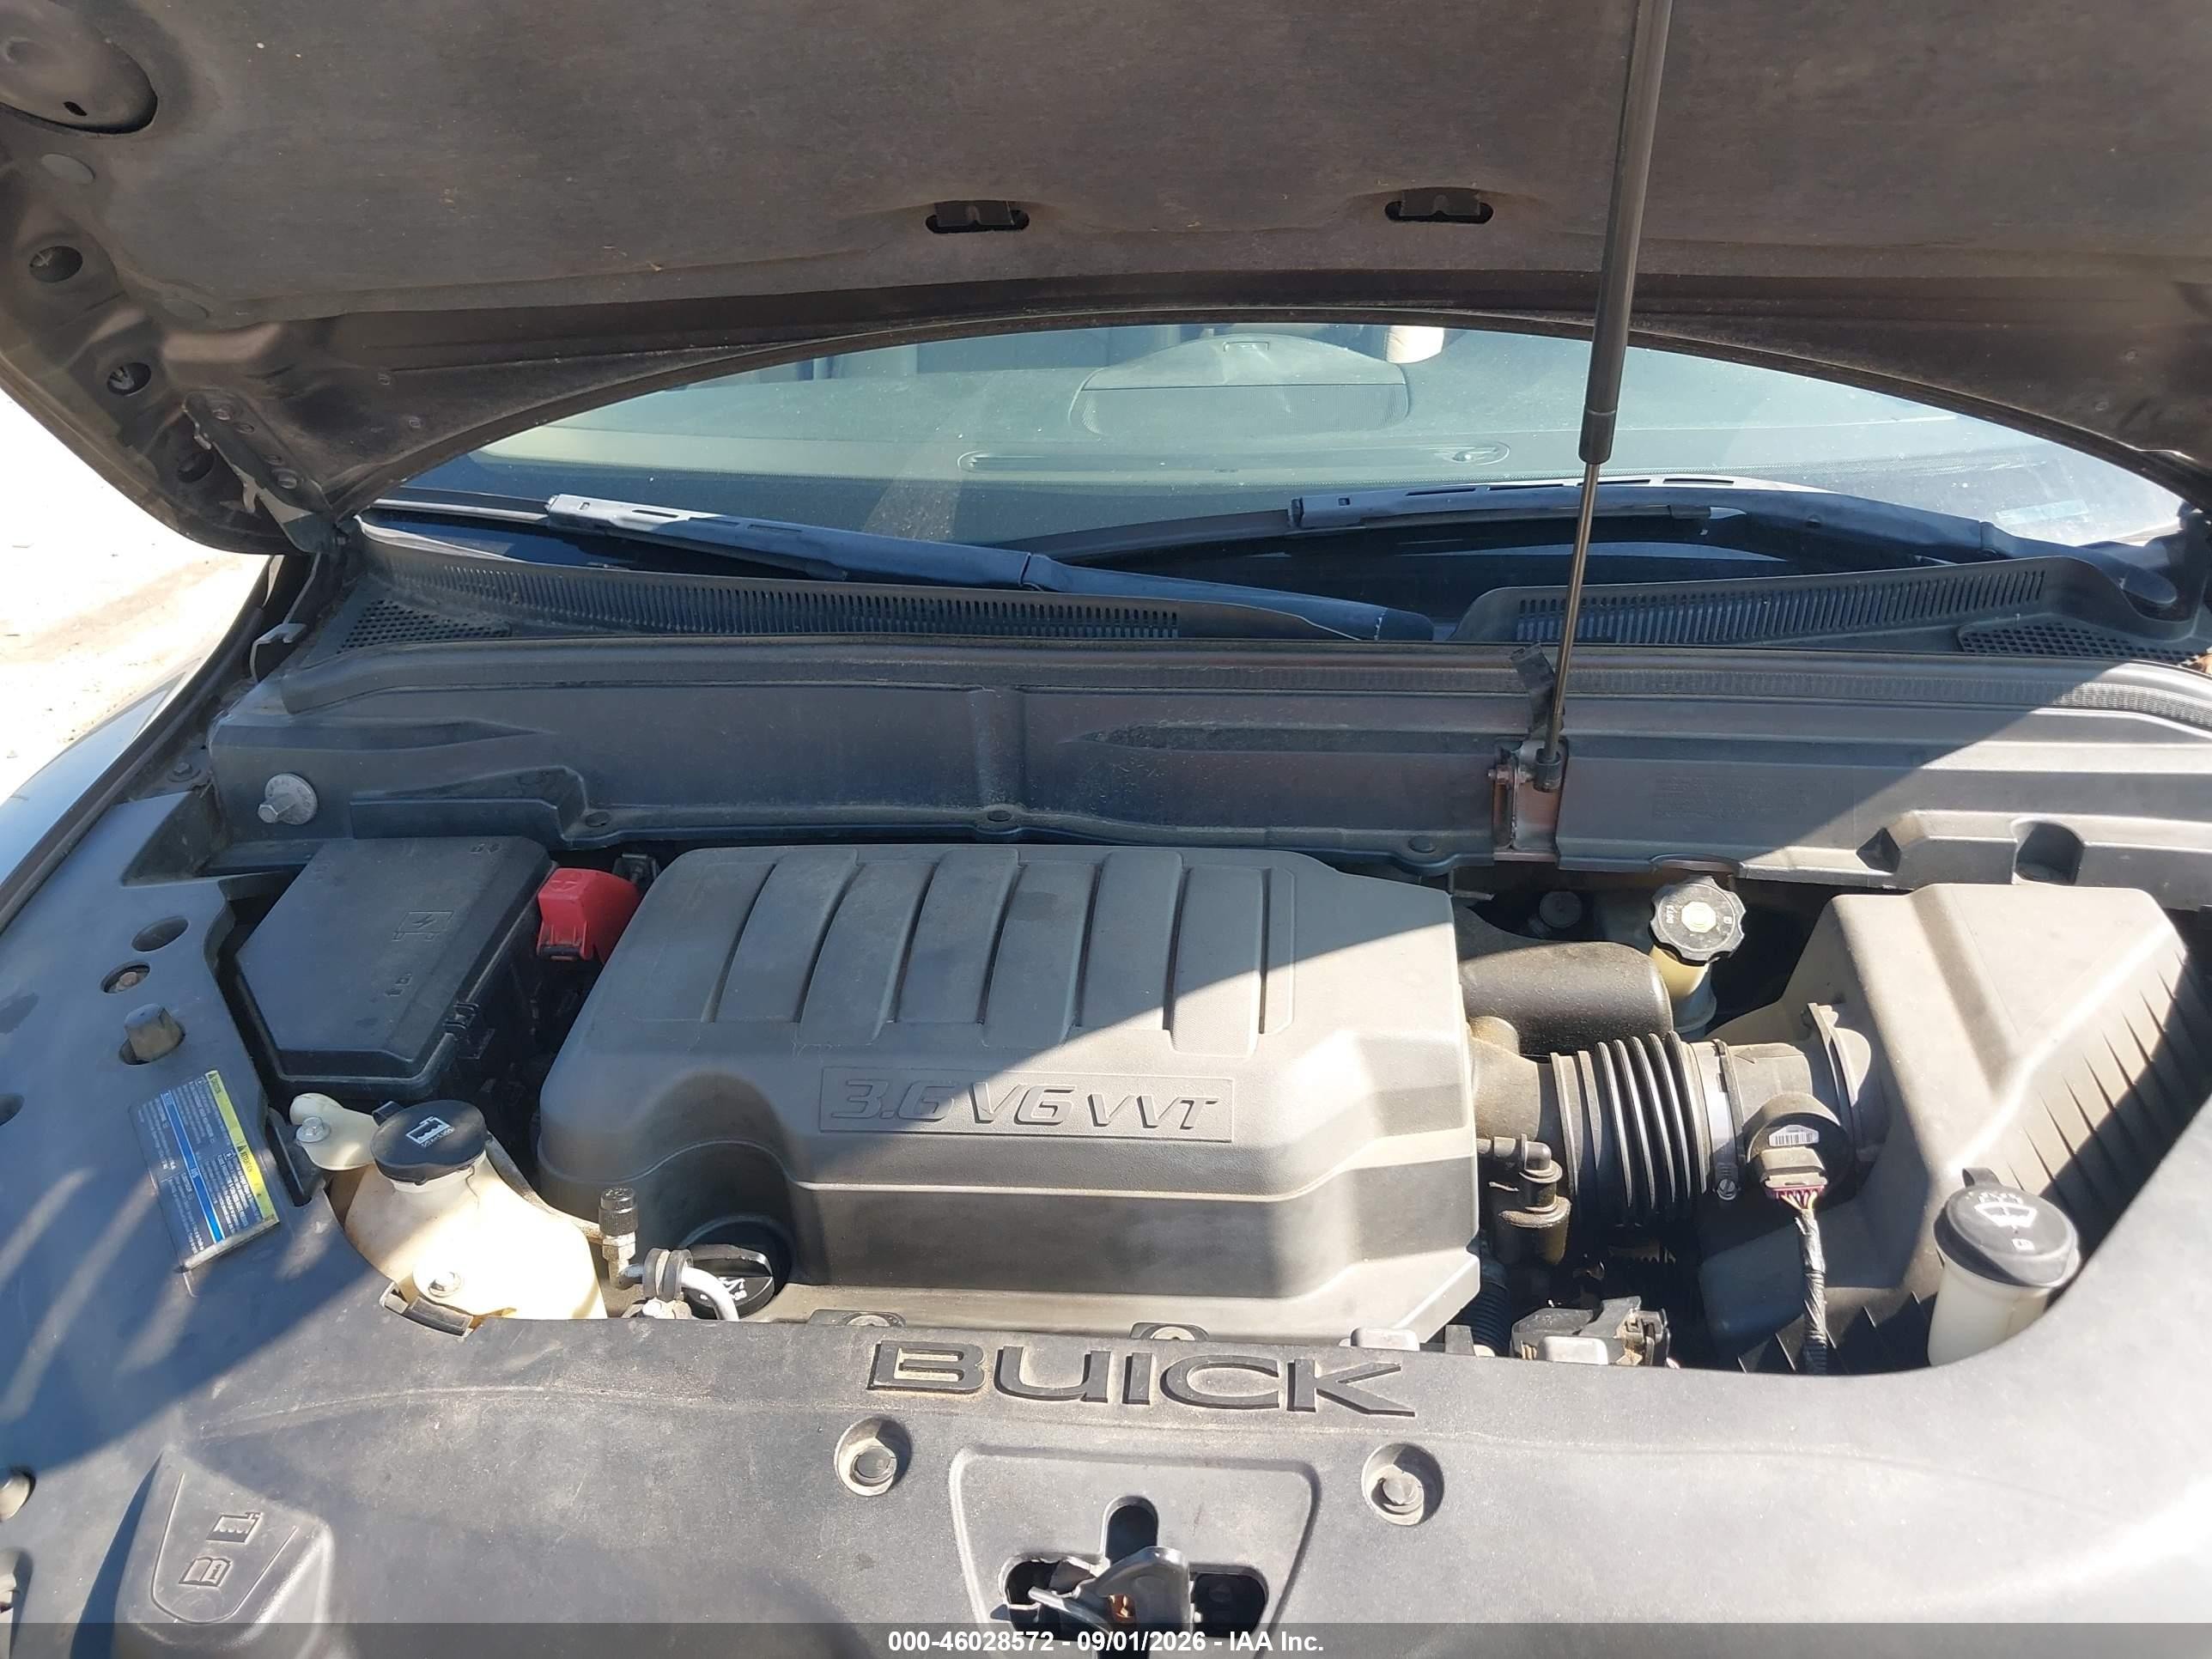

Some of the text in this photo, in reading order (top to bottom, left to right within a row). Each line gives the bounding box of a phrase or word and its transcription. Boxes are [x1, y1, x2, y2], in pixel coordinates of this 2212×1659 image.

[830, 1079, 1219, 1130] 3.6 V6 VVT
[866, 1340, 1416, 1418] BUICK
